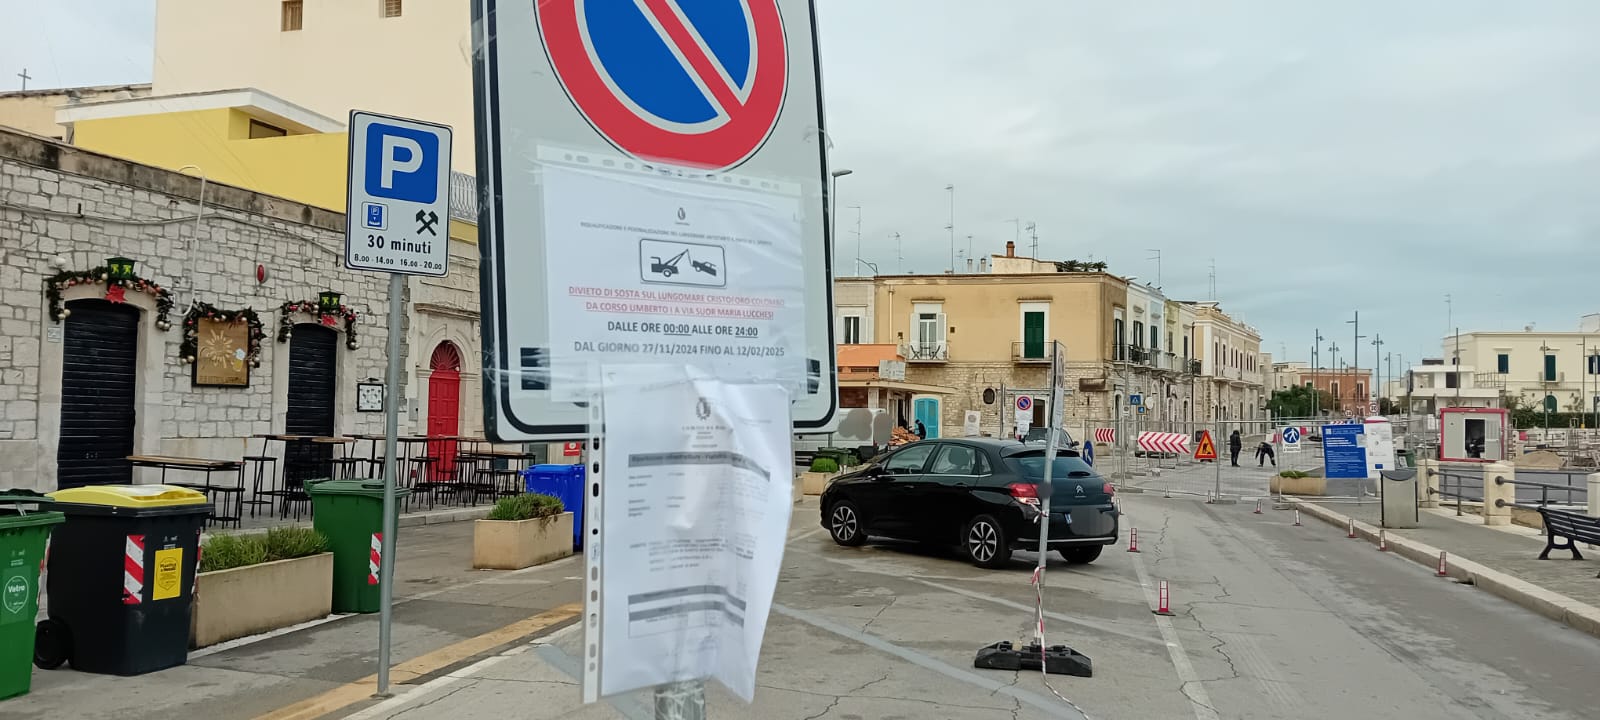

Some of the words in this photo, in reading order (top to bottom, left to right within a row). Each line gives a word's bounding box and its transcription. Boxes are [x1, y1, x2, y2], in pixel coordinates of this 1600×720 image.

[380, 134, 424, 190] P
[367, 234, 385, 249] 30
[390, 238, 432, 254] minuti
[354, 253, 370, 263] 8.00
[376, 256, 394, 265] 14.00
[400, 258, 418, 268] 16.00
[423, 260, 442, 270] 20.00
[568, 286, 602, 296] DIVIETO
[604, 288, 613, 297] DI
[614, 289, 640, 298] SOSTA
[642, 290, 656, 299] SUL
[658, 291, 705, 302] LUNGOMARE
[586, 302, 598, 310] DA
[600, 302, 628, 312] CORSO
[630, 304, 669, 313] UMBERTO
[696, 308, 716, 316] SUOR
[717, 308, 741, 317] MARIA
[608, 320, 638, 332] DALLE
[640, 322, 662, 333] ORE
[663, 323, 690, 334] 00:00
[692, 324, 712, 334] ALLE
[715, 326, 733, 336] ORE
[734, 326, 758, 336] 24:00
[574, 341, 595, 352] DAL
[598, 342, 640, 353] GIORNO
[642, 343, 698, 355] 27/11/2024
[700, 345, 721, 355] FINO
[724, 346, 735, 355] AL
[737, 346, 785, 358] 12/02/2025
[8, 584, 26, 594] Vetro
